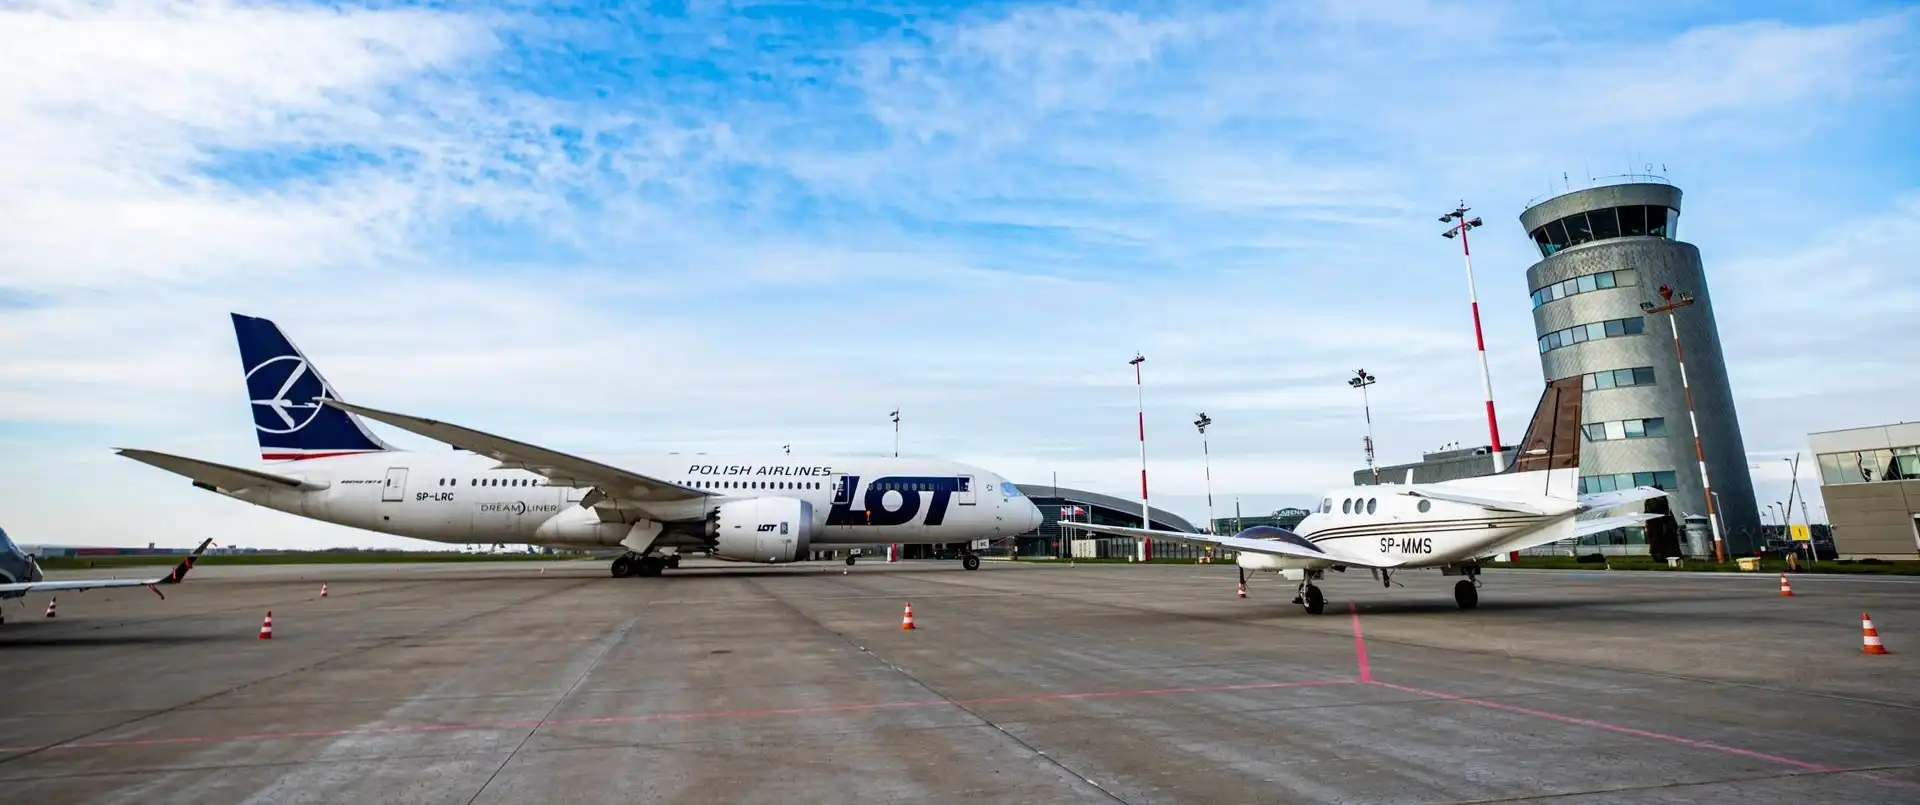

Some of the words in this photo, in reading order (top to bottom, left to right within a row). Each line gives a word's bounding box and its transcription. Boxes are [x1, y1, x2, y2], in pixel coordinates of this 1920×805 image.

[688, 465, 752, 475] POLISH
[756, 466, 832, 476] AIRLINES
[416, 492, 454, 501] SP-LRC
[825, 475, 970, 525] LOT
[480, 501, 557, 515] DREAMLINER
[756, 524, 777, 532] LOT
[1380, 537, 1432, 554] SP-MMS
